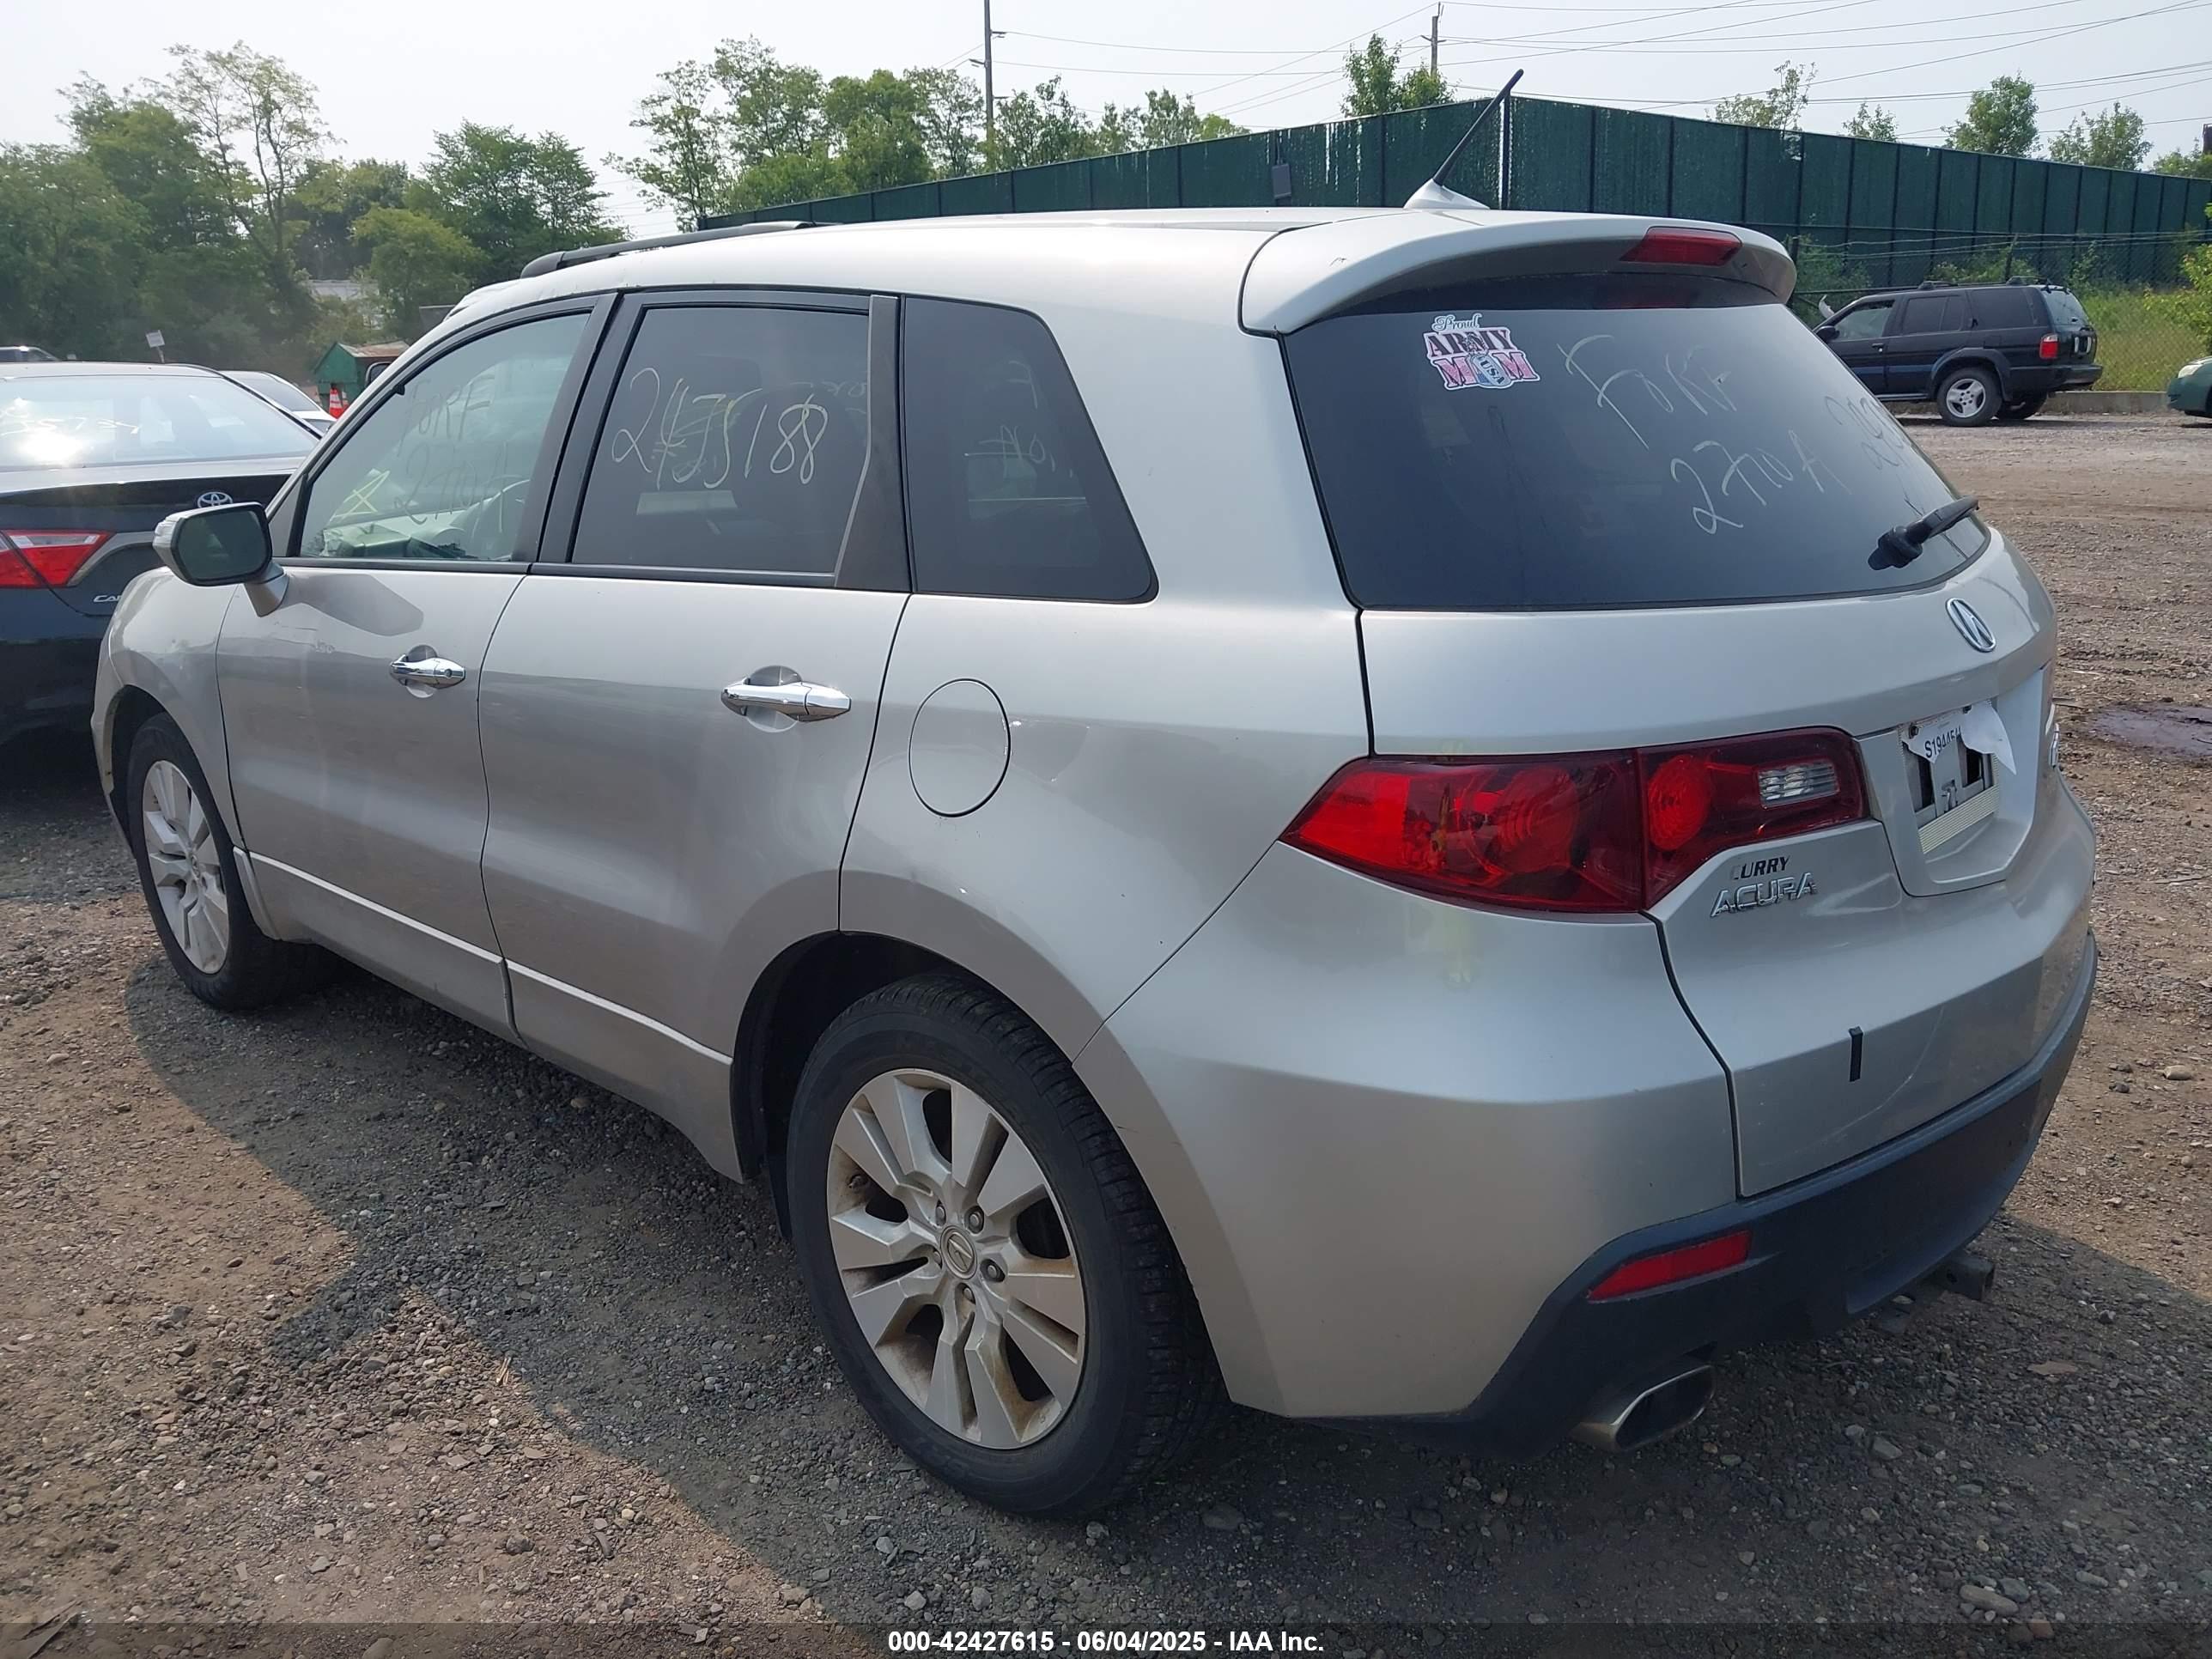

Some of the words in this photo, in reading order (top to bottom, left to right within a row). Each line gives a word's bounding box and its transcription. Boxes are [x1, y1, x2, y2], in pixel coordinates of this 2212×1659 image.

[1432, 314, 1482, 331] Proud
[1426, 329, 1516, 358] ARMY
[1480, 360, 1505, 385] USA
[1710, 872, 1819, 917] ACURA
